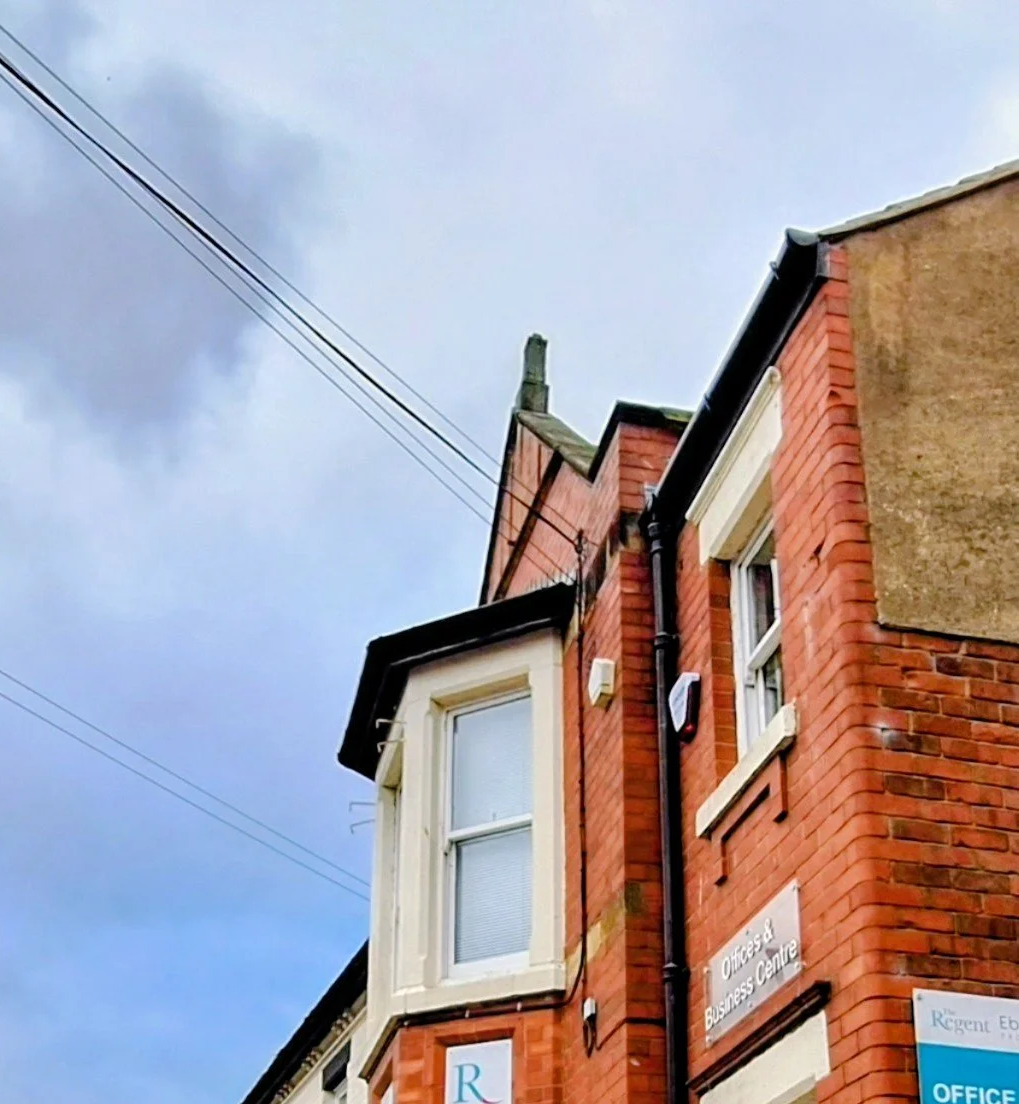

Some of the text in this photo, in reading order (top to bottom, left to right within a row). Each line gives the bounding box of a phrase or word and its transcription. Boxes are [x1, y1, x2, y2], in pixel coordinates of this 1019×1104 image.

[721, 918, 773, 980] Offices &
[705, 939, 798, 1031] Business Centre
[931, 1009, 991, 1036] Regent
